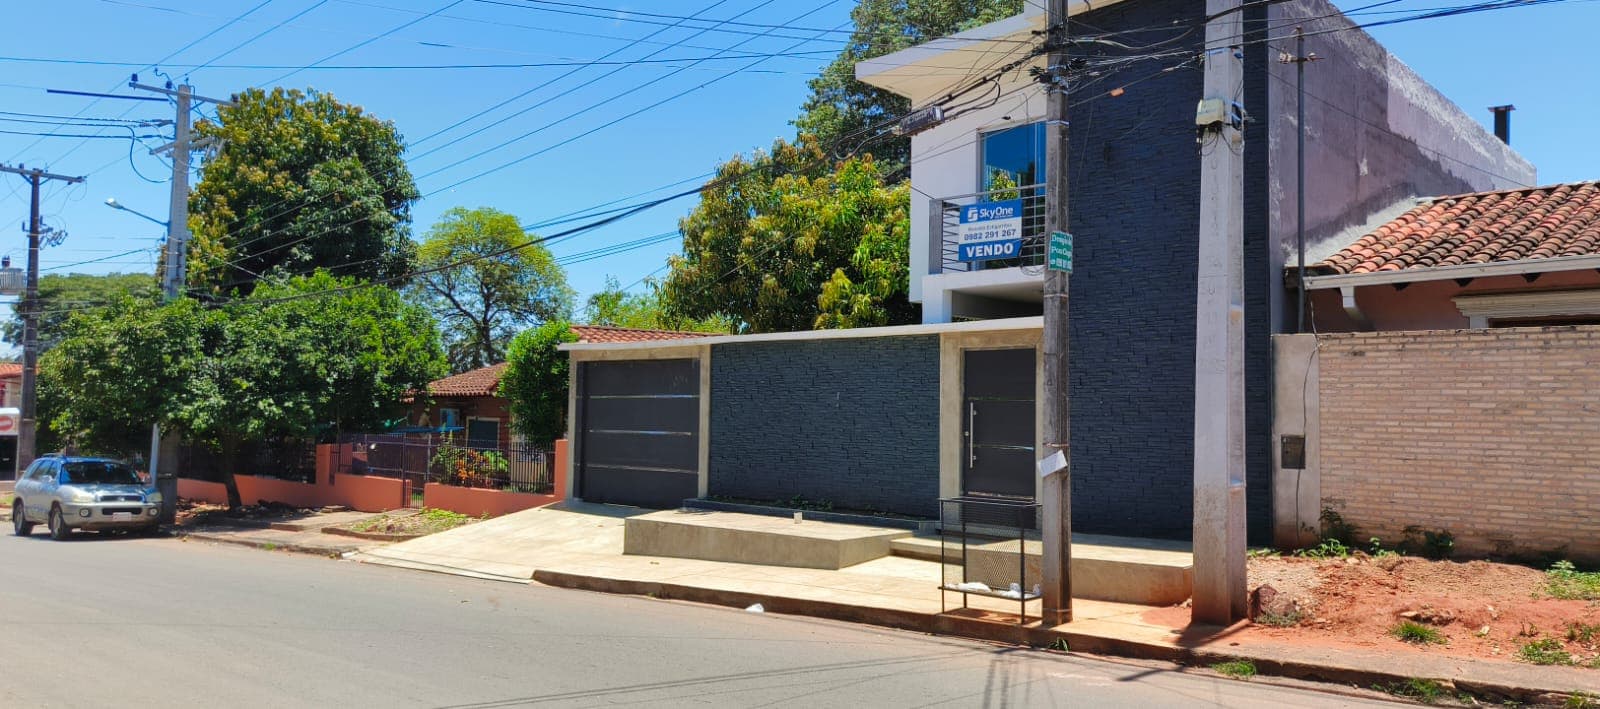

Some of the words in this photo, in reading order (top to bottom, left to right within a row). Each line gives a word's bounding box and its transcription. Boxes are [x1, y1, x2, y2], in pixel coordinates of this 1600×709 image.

[979, 206, 1014, 219] SkyOne
[985, 231, 999, 239] 291
[1001, 229, 1017, 237] 267
[966, 243, 1014, 258] VENDO
